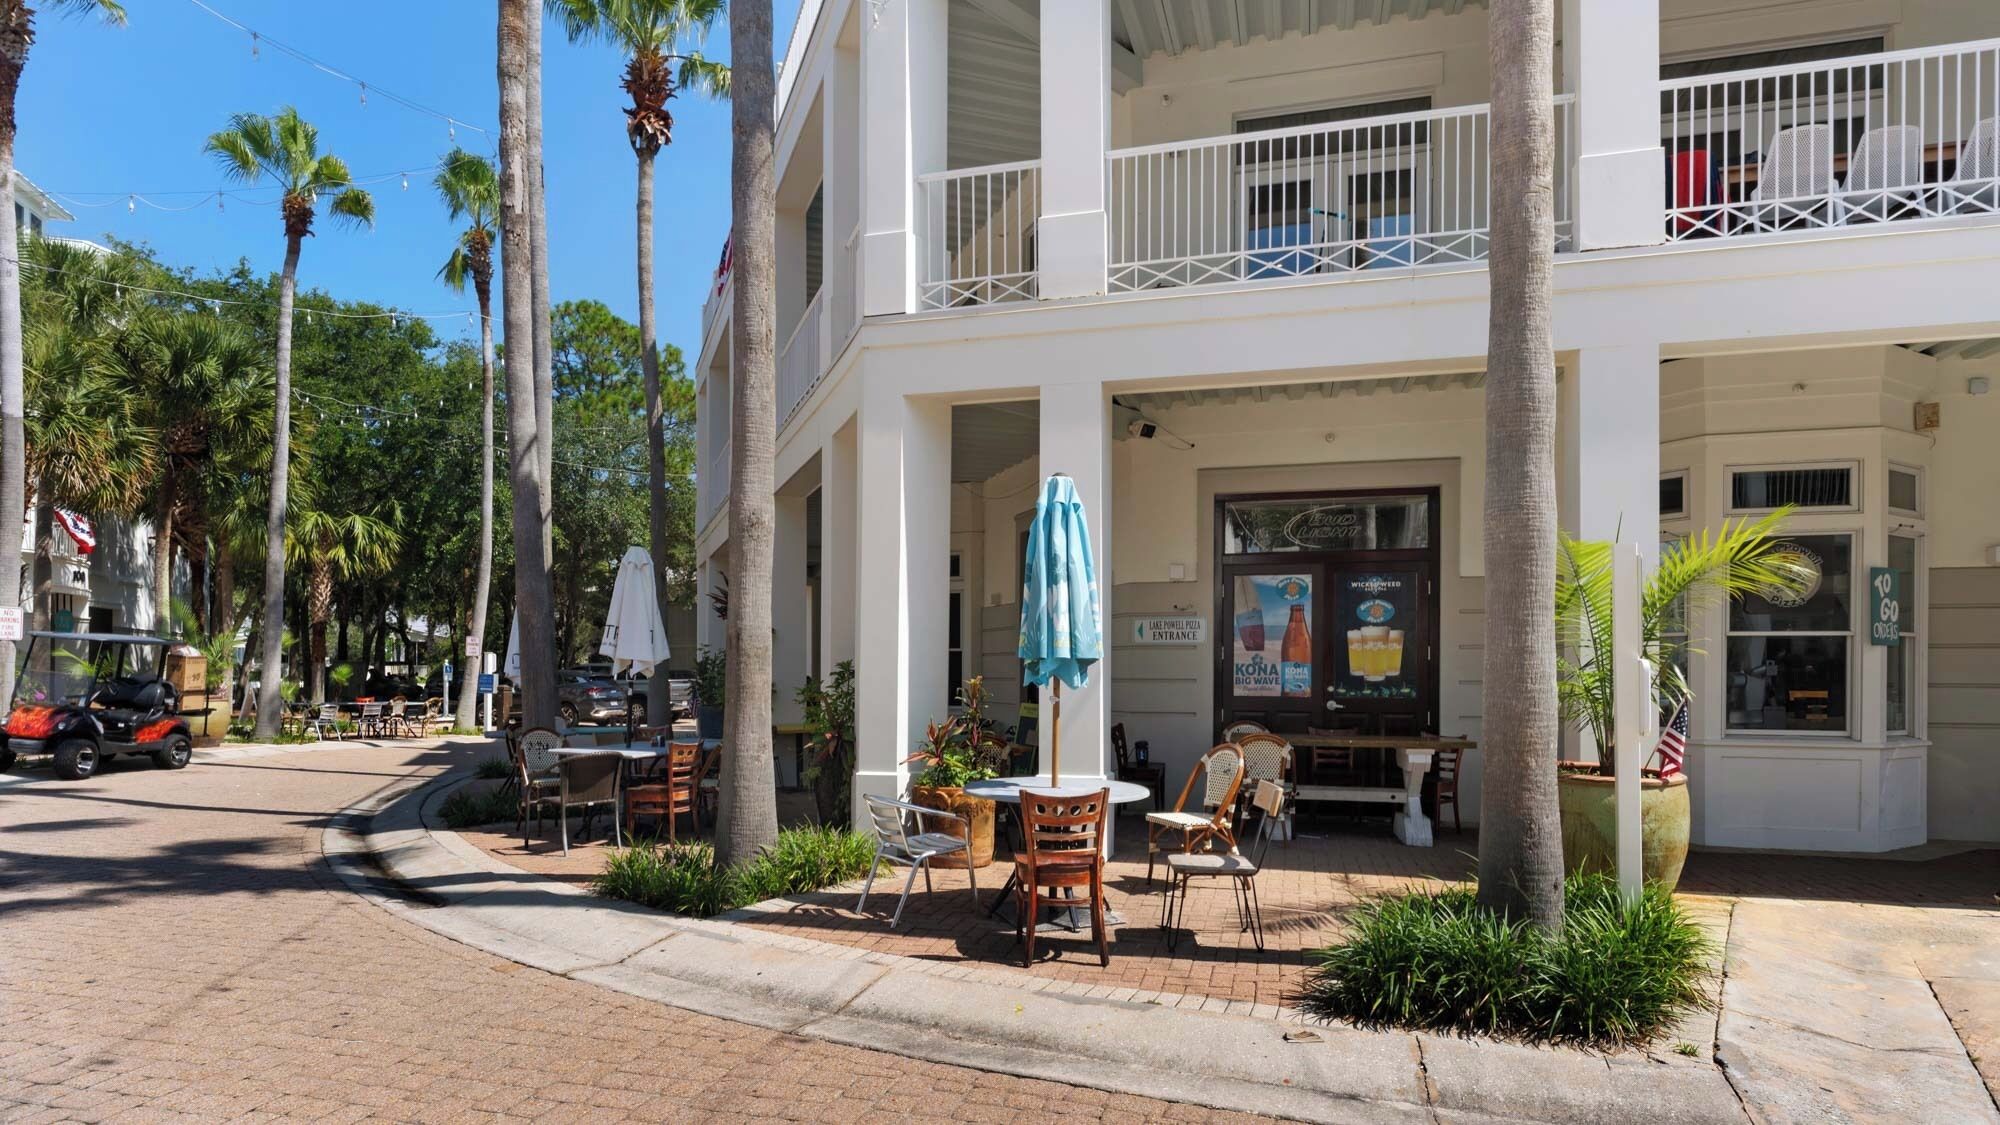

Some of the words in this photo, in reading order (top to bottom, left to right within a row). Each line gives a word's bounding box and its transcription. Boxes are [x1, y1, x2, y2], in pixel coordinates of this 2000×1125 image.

[1308, 512, 1357, 526] BUD
[1296, 526, 1362, 539] LIGHT
[1380, 580, 1401, 588] WEED
[1874, 573, 1891, 598] TO
[1881, 597, 1899, 622] GO
[1149, 620, 1162, 630] LAKE
[1164, 620, 1184, 630] POWELL
[1186, 620, 1200, 630] PIZZA
[1873, 622, 1898, 640] ORDERS
[1153, 631, 1197, 640] ENTRANCE
[1235, 663, 1279, 676] KONA
[1235, 676, 1251, 685] BIG
[1254, 676, 1280, 685] WAVE
